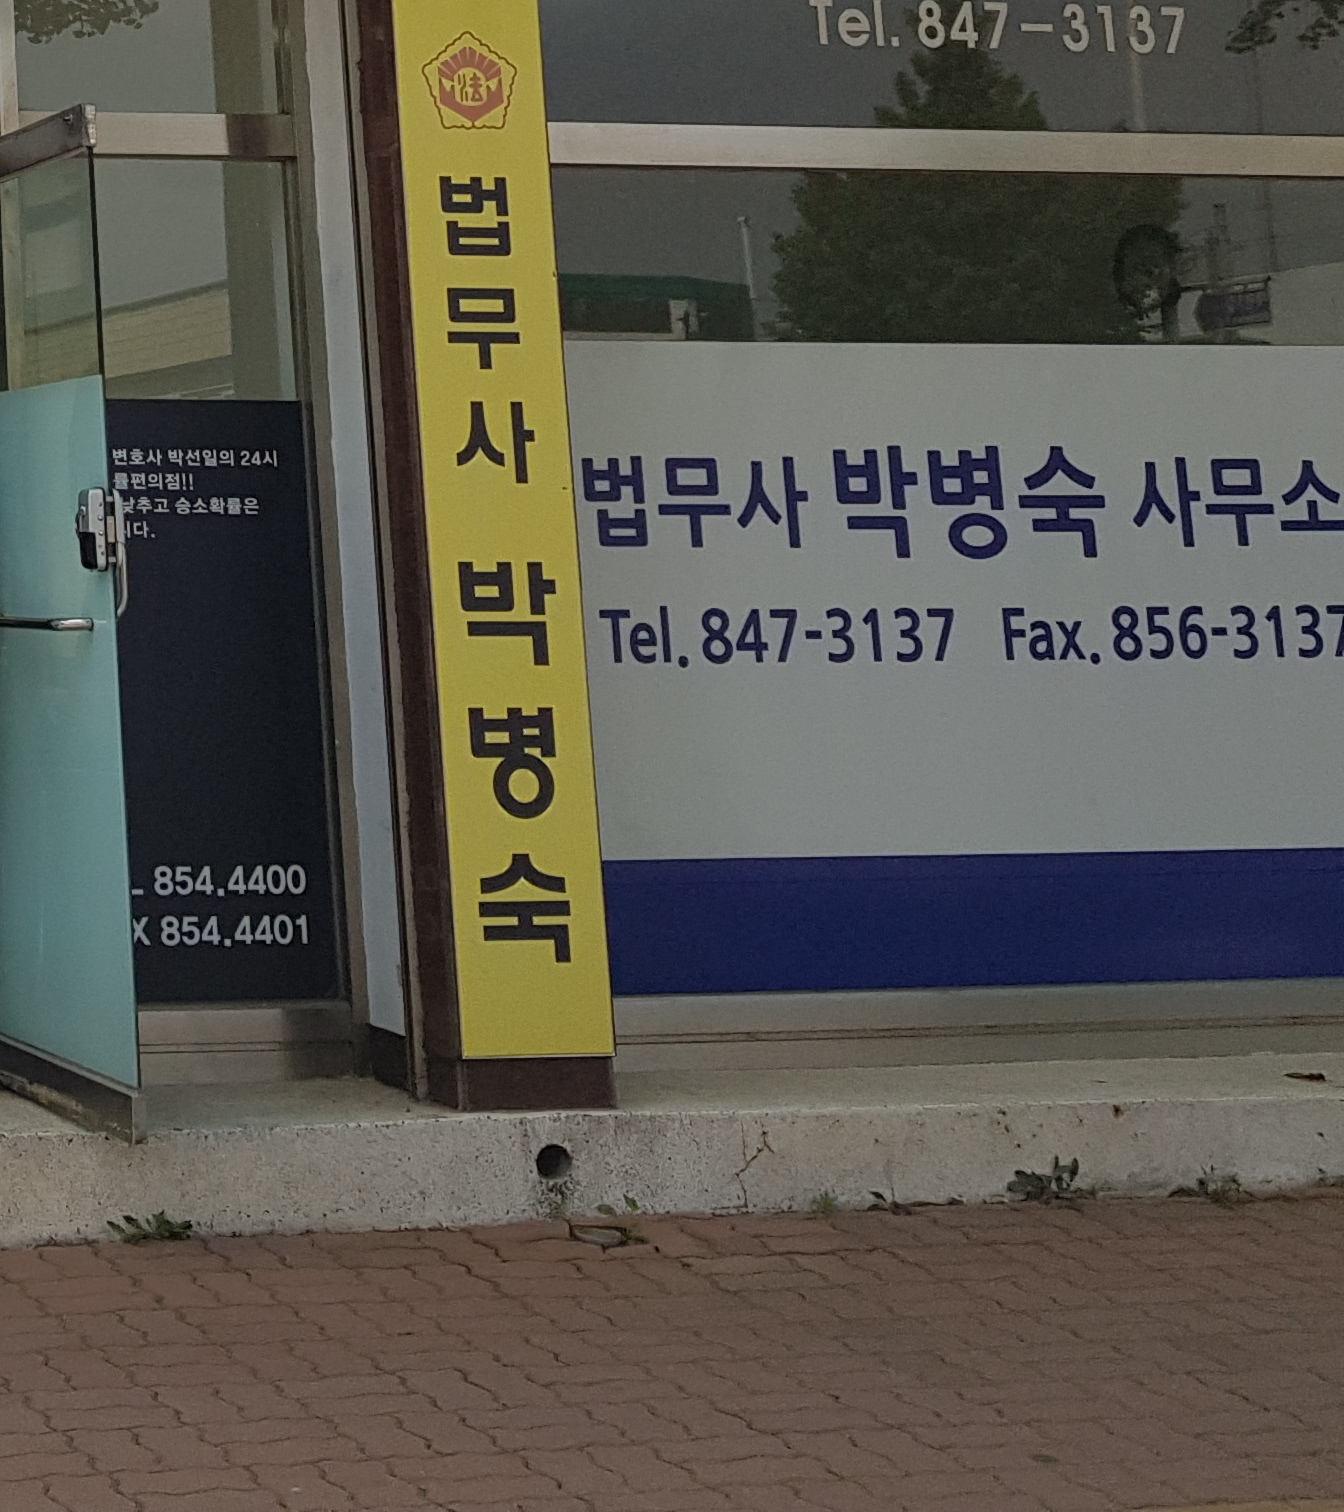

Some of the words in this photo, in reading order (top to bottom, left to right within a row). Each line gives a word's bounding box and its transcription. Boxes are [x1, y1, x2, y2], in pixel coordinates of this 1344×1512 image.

[917, 0, 1185, 54] 847-3137
[438, 175, 536, 484] 법무사
[112, 448, 162, 467] 변호사
[167, 448, 235, 467] 박선일의
[240, 449, 278, 468] 24시
[580, 455, 809, 549] 법무사
[832, 445, 1106, 560] 박병숙
[1133, 456, 1344, 548] 사무소
[458, 560, 572, 963] 박병숙
[153, 864, 307, 897] 854.4400
[160, 914, 309, 947] 854.4401
